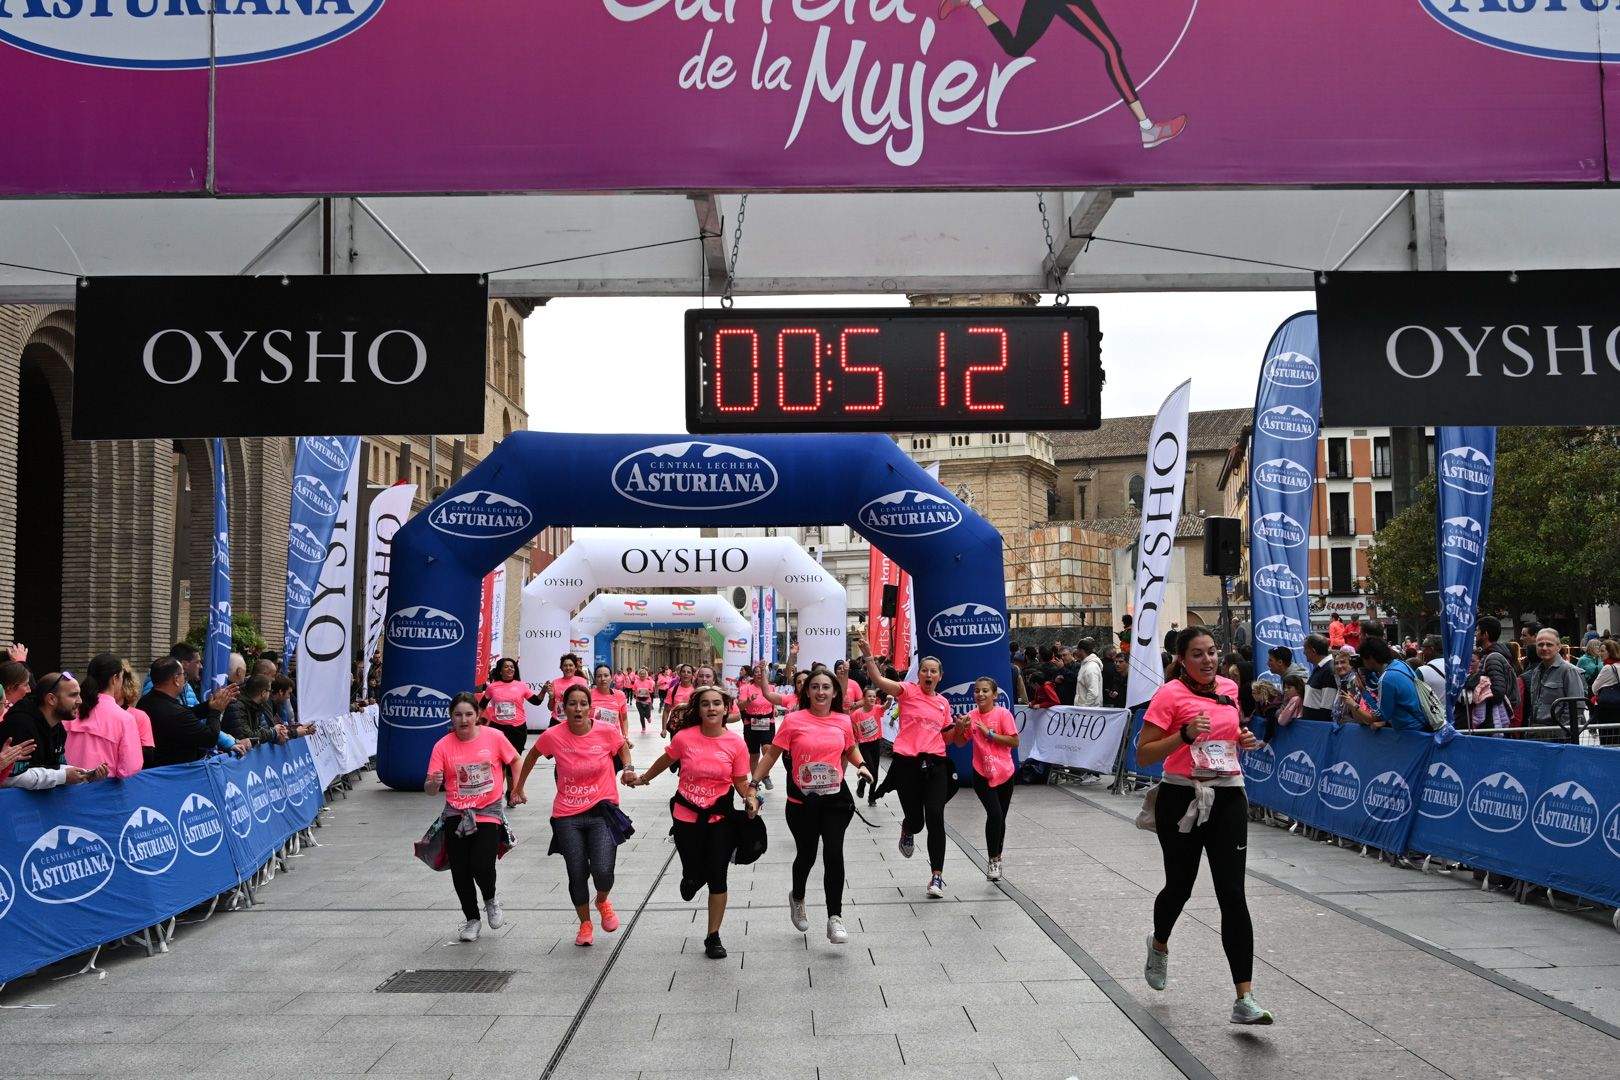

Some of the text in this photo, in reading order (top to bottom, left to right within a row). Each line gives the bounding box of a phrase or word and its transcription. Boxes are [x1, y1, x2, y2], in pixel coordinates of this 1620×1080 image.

[679, 17, 1036, 166] de la Mujer
[142, 328, 428, 385] OYSHO
[1385, 324, 1620, 380] OYSH
[1262, 416, 1312, 433] ASTURIANA
[624, 462, 767, 492] ASTURIANA
[651, 461, 760, 470] CENTRAL LECHERA
[1258, 468, 1307, 487] ASTURIANA
[294, 480, 332, 513] ASTURIANA
[433, 507, 524, 527] ASTURIANA
[867, 509, 956, 526] ASTURIANA
[621, 547, 749, 574] OYSHO
[544, 578, 583, 587] OYSHO
[785, 574, 823, 584] OYSHO
[388, 621, 458, 639] ASTURIANA
[525, 629, 562, 639] OYSHO
[805, 627, 841, 636] OYSHO
[933, 621, 1002, 637] ASTURIANA
[382, 700, 451, 718] ASTURIANA
[1047, 712, 1106, 740] OYSHO
[1471, 790, 1523, 820] ASTURIANA
[1535, 801, 1592, 834] ASTURIANA
[183, 818, 222, 844] ASTURIANA
[127, 834, 176, 864] ASTURIANA
[31, 853, 110, 892] ASTURIANA
